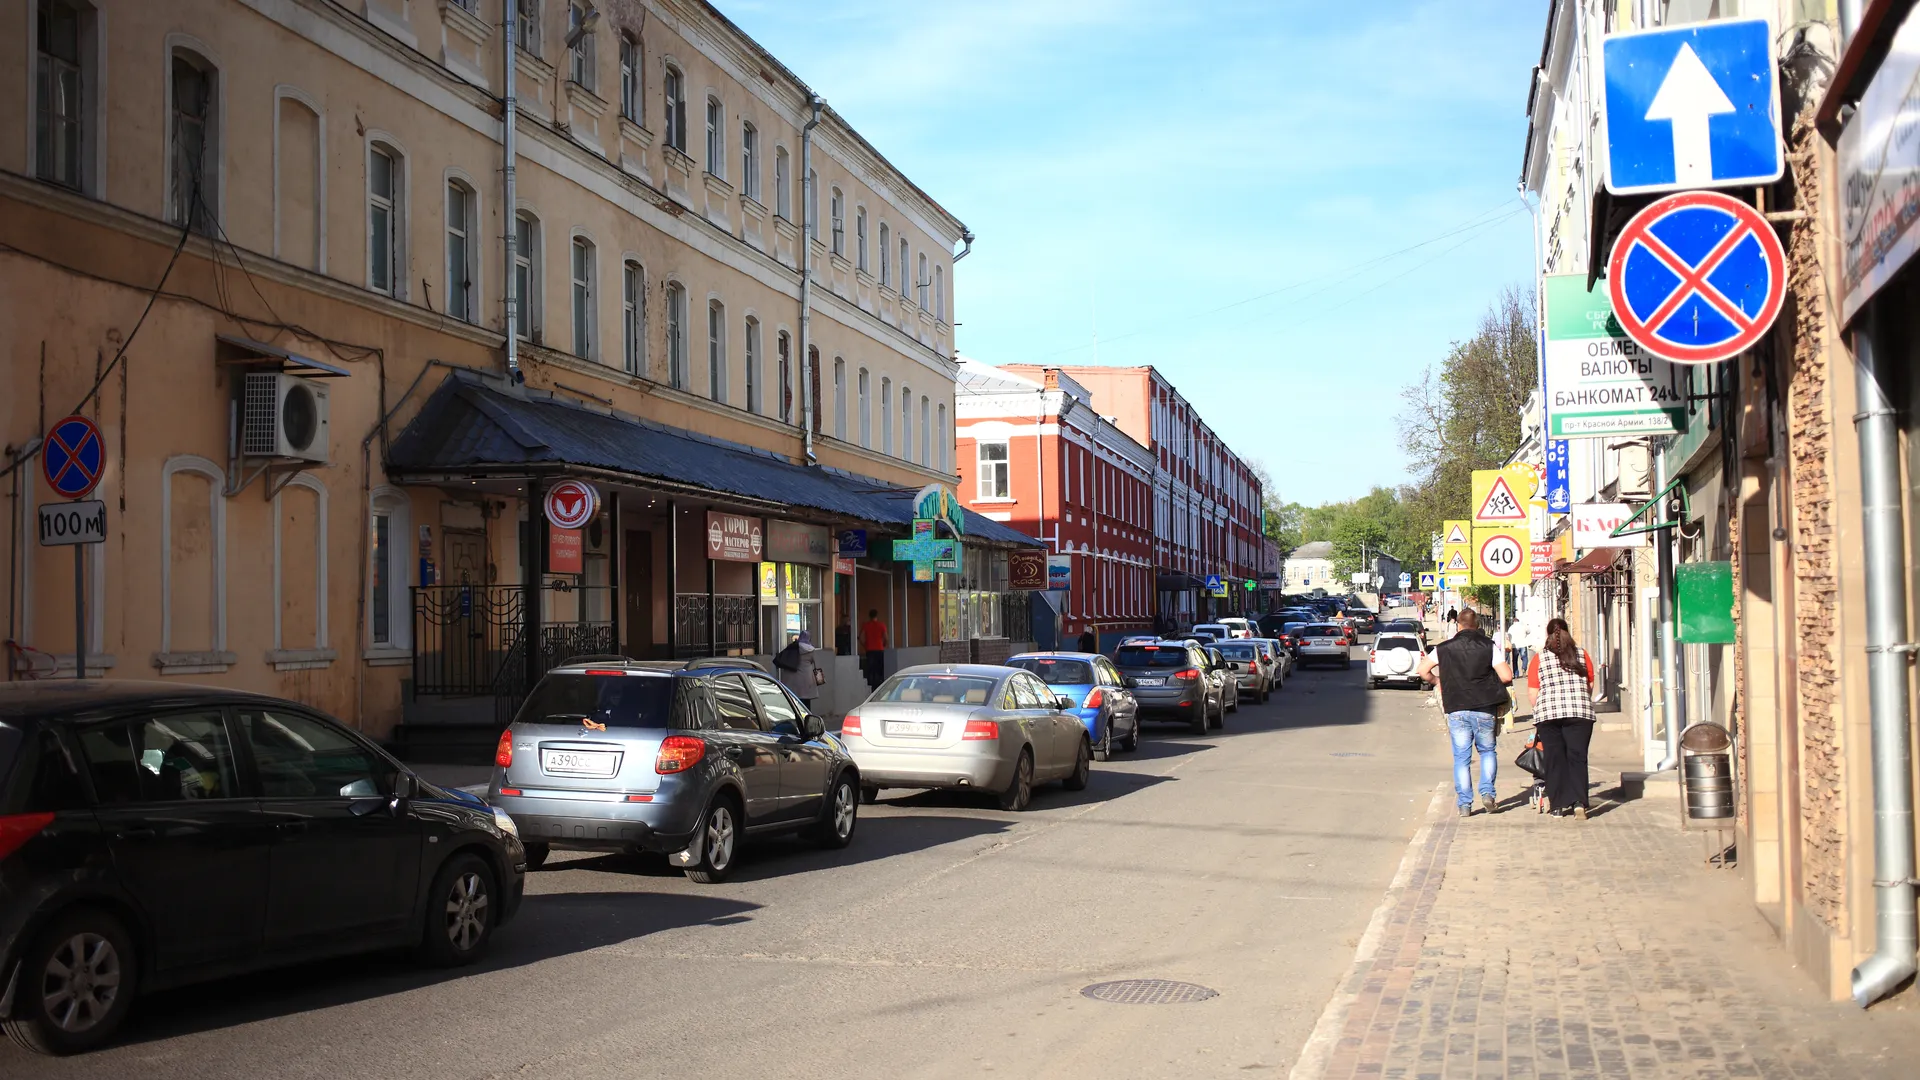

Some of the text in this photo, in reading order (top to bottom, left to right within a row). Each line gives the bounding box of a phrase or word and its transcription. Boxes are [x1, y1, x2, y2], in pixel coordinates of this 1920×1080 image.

[1581, 358, 1652, 376] ВАЛЮТЫ
[1555, 387, 1645, 406] БАНКОМАТ
[1565, 422, 1580, 430] пр-т
[1583, 418, 1616, 428] Красной
[1648, 416, 1668, 425] 138/2
[1557, 440, 1566, 480] СТИ
[44, 511, 82, 537] 100
[724, 517, 749, 536] ГОРОД
[725, 536, 749, 549] МАСТЕРОВ
[1490, 547, 1514, 564] 40
